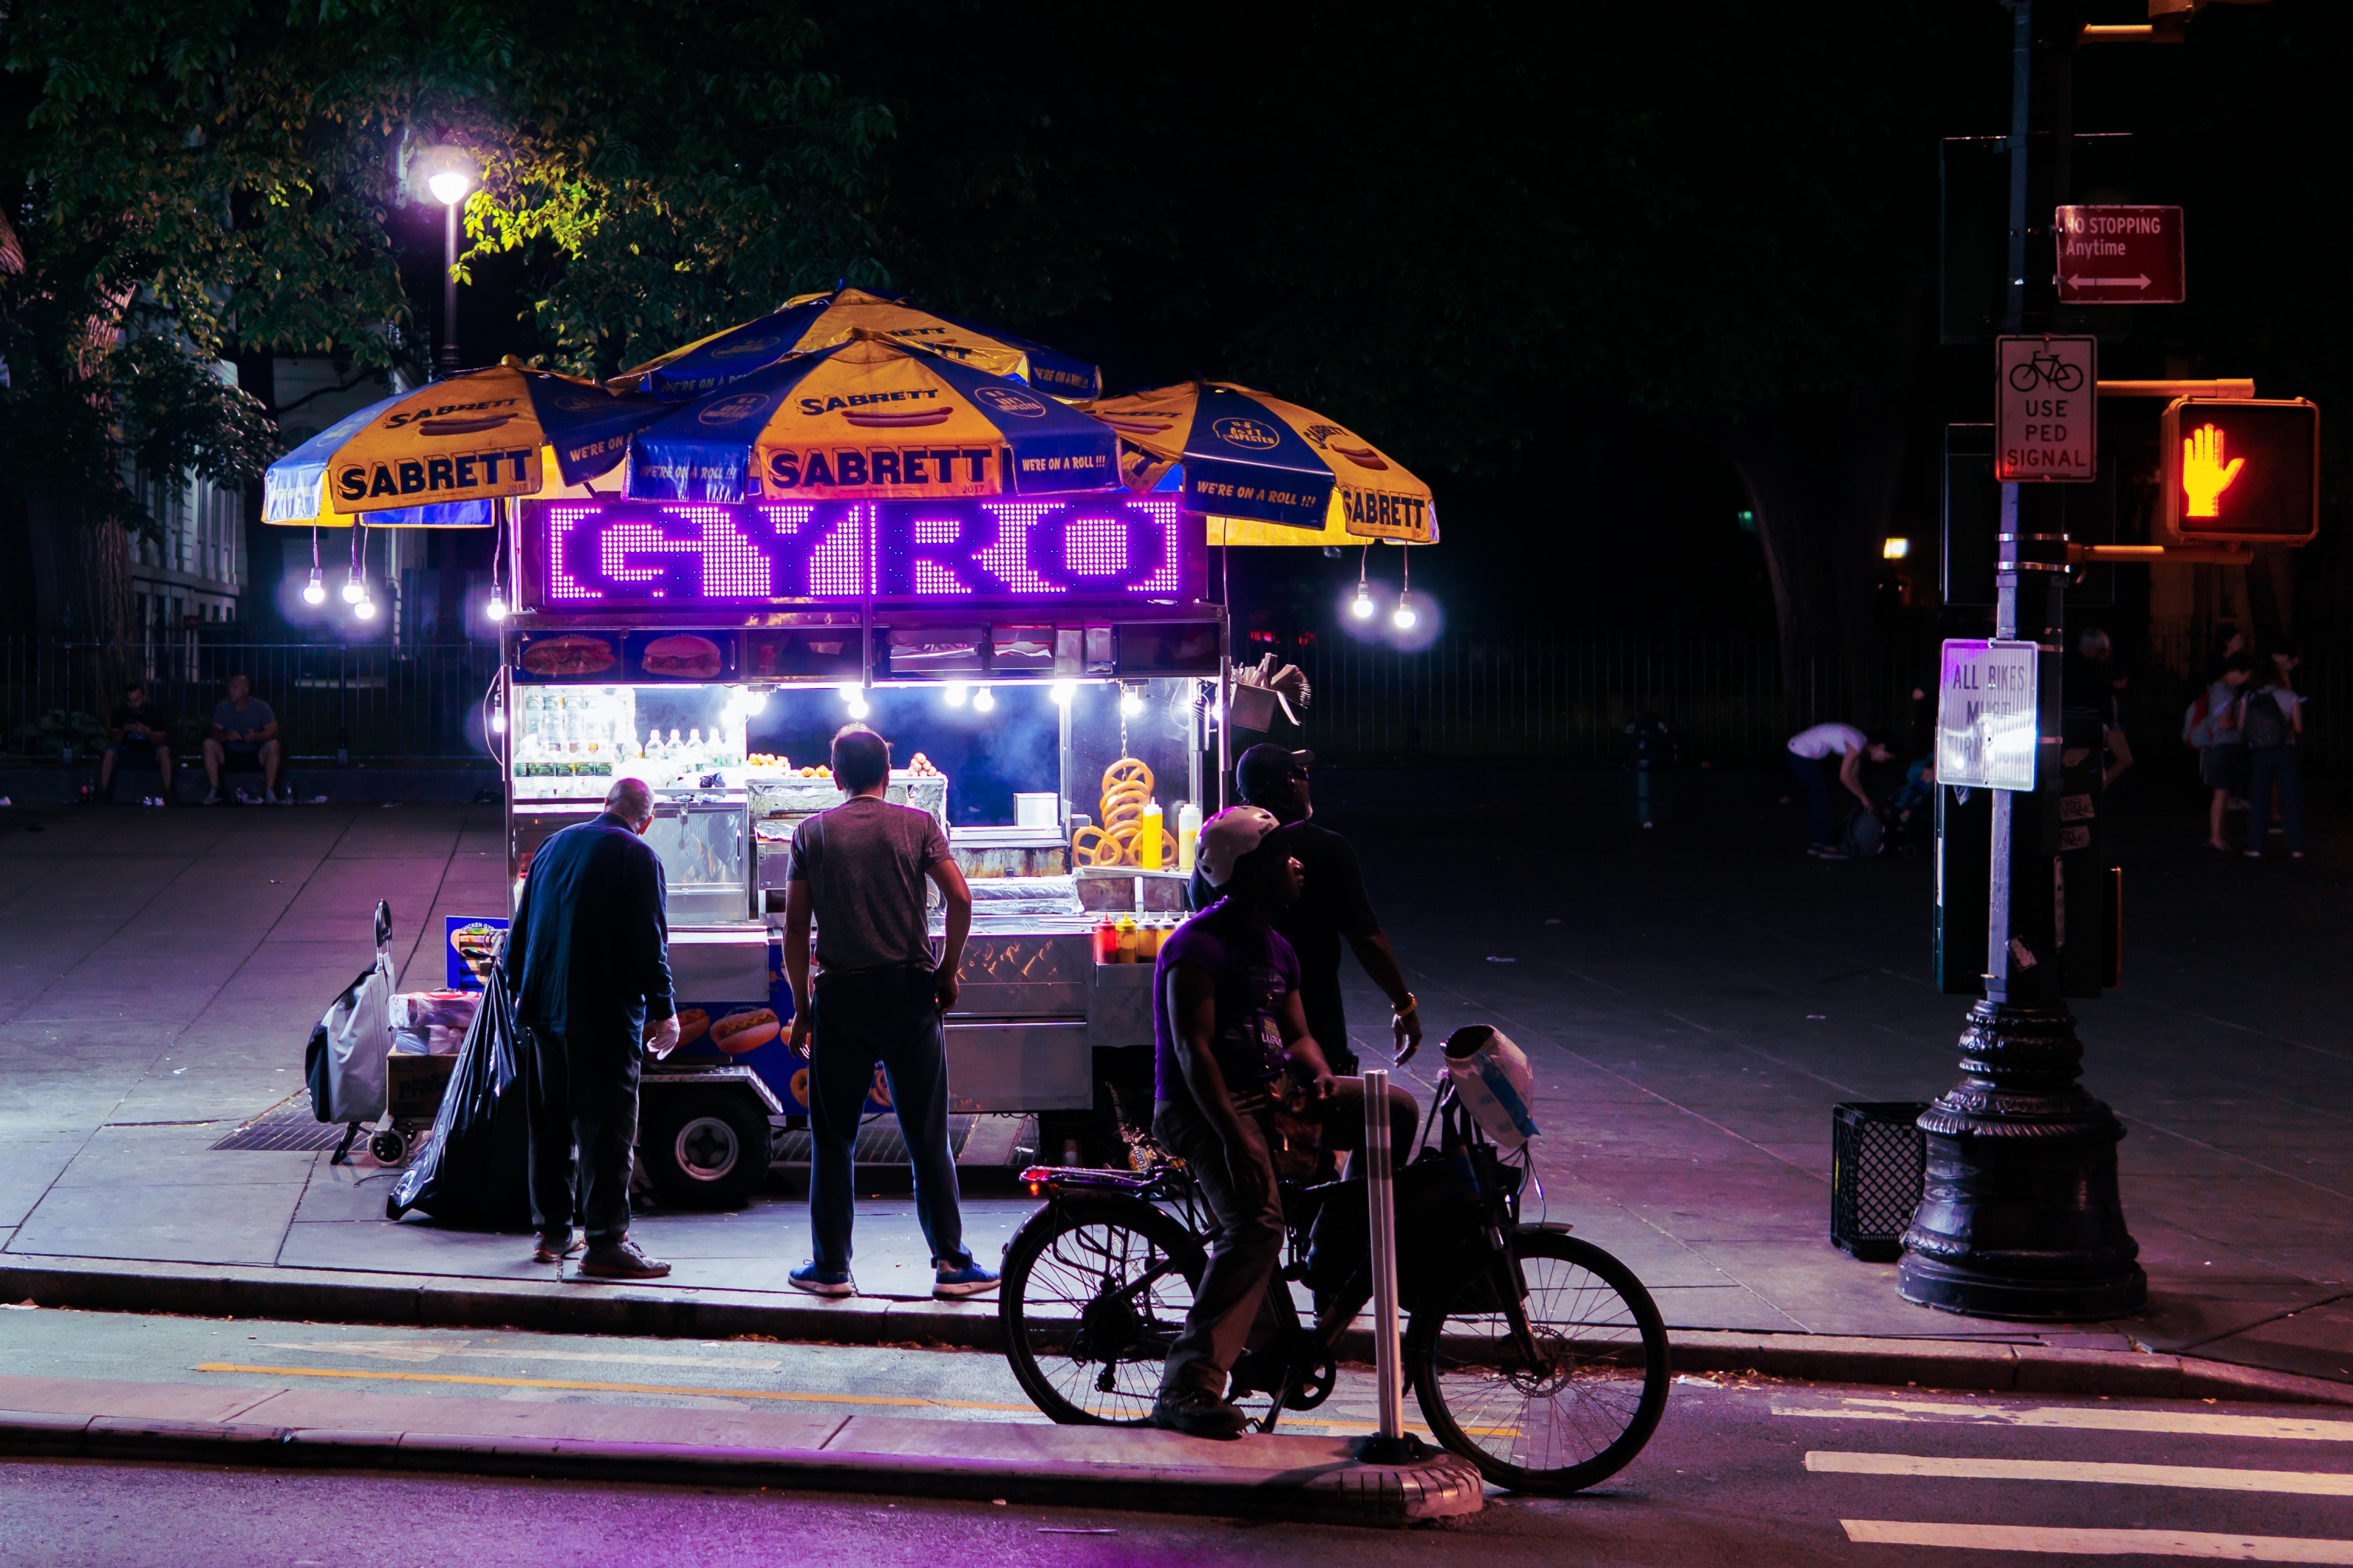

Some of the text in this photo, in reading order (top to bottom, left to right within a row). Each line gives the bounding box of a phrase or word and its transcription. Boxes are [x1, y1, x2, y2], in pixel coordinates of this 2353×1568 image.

[2065, 217, 2161, 235] NO STOPPING
[2065, 238, 2127, 259] Anytime
[699, 376, 713, 390] ON
[718, 375, 724, 387] A
[1055, 370, 1065, 383] ON
[795, 387, 939, 416] SABRETT
[2026, 400, 2067, 417] USE
[382, 397, 520, 429] SABRETT
[2026, 425, 2066, 442] PED
[570, 441, 605, 462] WE'RE
[607, 434, 624, 450] ON
[766, 443, 993, 489] SABRETT
[1022, 455, 1106, 472] WE'RE ON A ROLL !!!
[2007, 449, 2086, 466] SIGNAL
[337, 445, 533, 501] SABRETT
[640, 465, 672, 479] WE'RE
[674, 465, 689, 479] ON
[701, 466, 724, 480] ROLL
[1122, 471, 1138, 486] 018
[507, 483, 527, 494] 2017
[963, 484, 985, 494] 2017
[1197, 481, 1316, 509] WE'RE ON A ROLL !!!
[562, 503, 1171, 598] GYRO
[1953, 664, 2025, 691] ALL BIKES
[1133, 1149, 1148, 1170] FOGO
